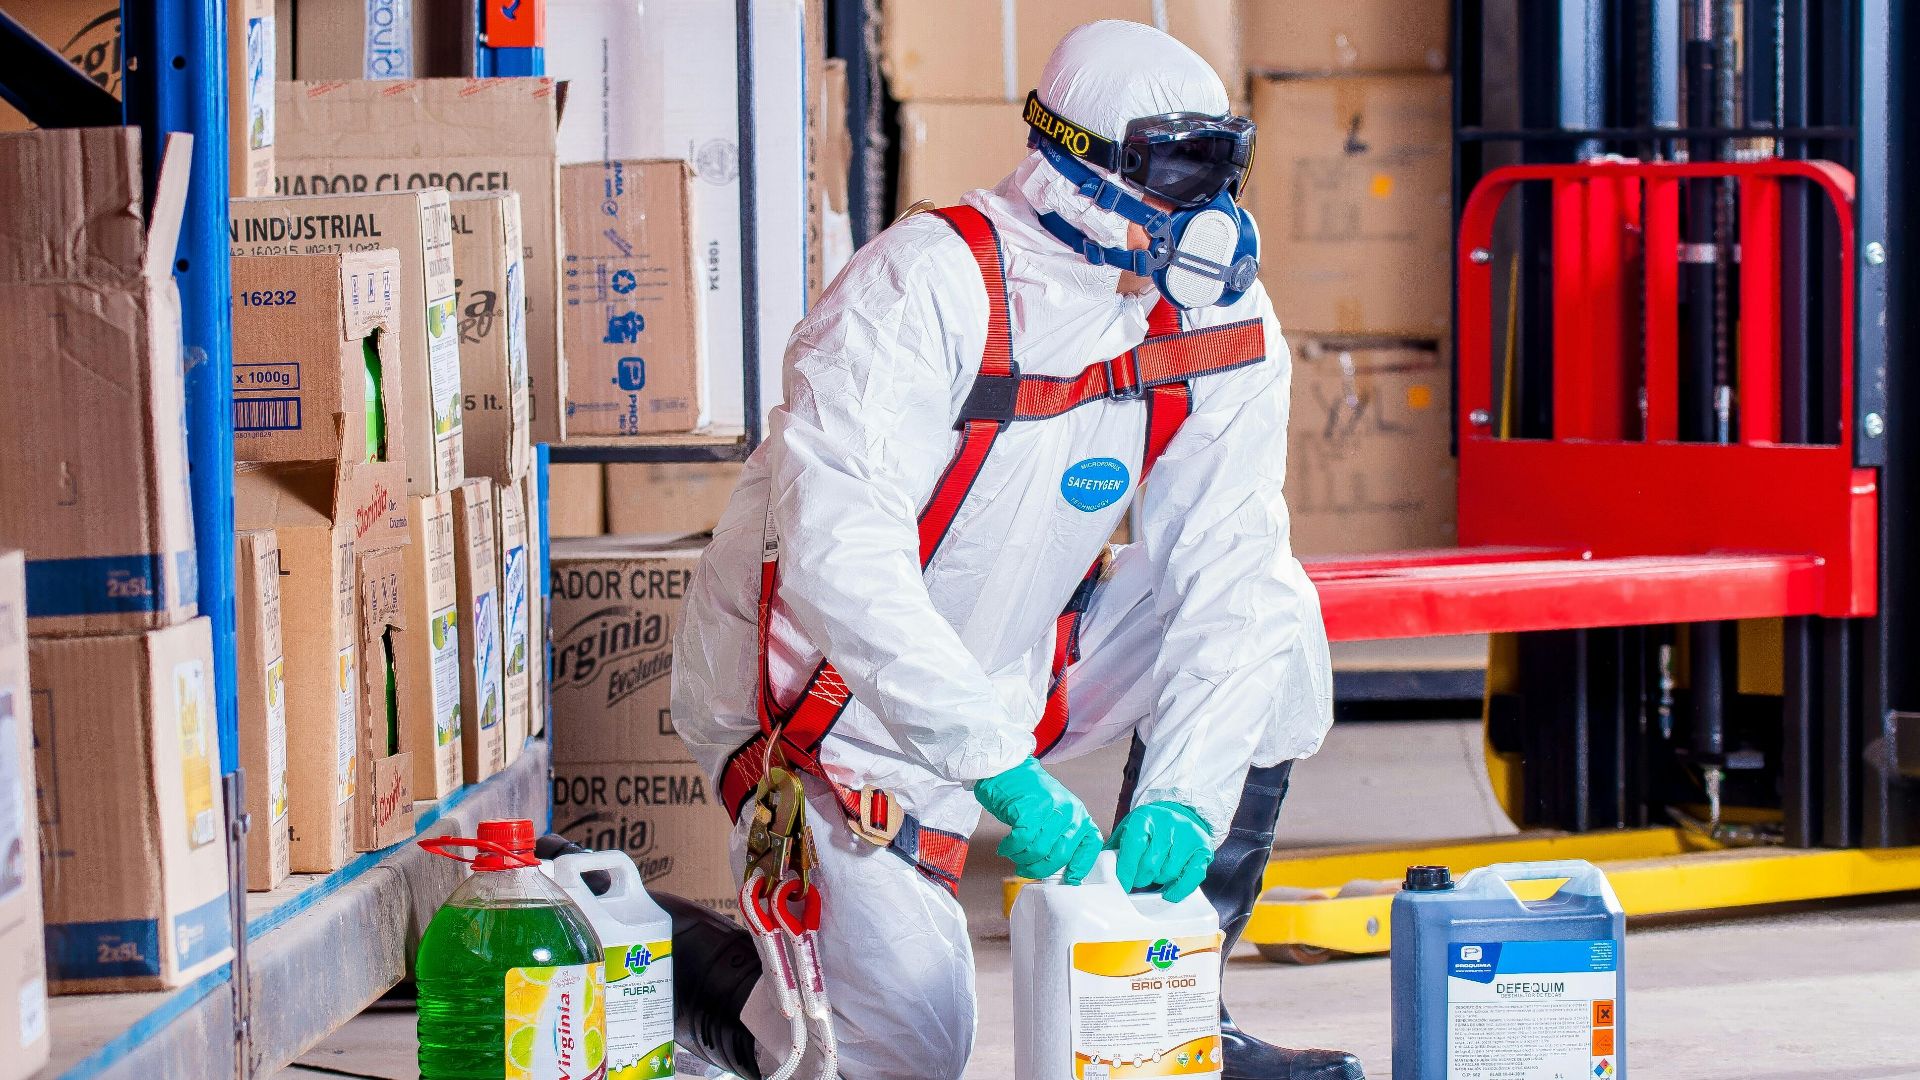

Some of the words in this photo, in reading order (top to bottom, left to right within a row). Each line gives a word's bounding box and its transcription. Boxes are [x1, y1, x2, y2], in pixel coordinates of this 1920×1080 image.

[1026, 98, 1090, 157] STEELPRO
[245, 213, 382, 242] INDUSTRIAL
[240, 290, 297, 307] 16232
[235, 374, 244, 384] x
[248, 371, 290, 385] 1000g
[464, 394, 476, 411] 5
[616, 776, 707, 806] CREMA
[625, 948, 651, 968] Hit
[1146, 942, 1180, 962] Hit
[623, 985, 657, 997] FUERA
[1132, 981, 1163, 991] BRIO
[1166, 978, 1197, 989] 1000
[1496, 982, 1564, 994] DEFEQUIM
